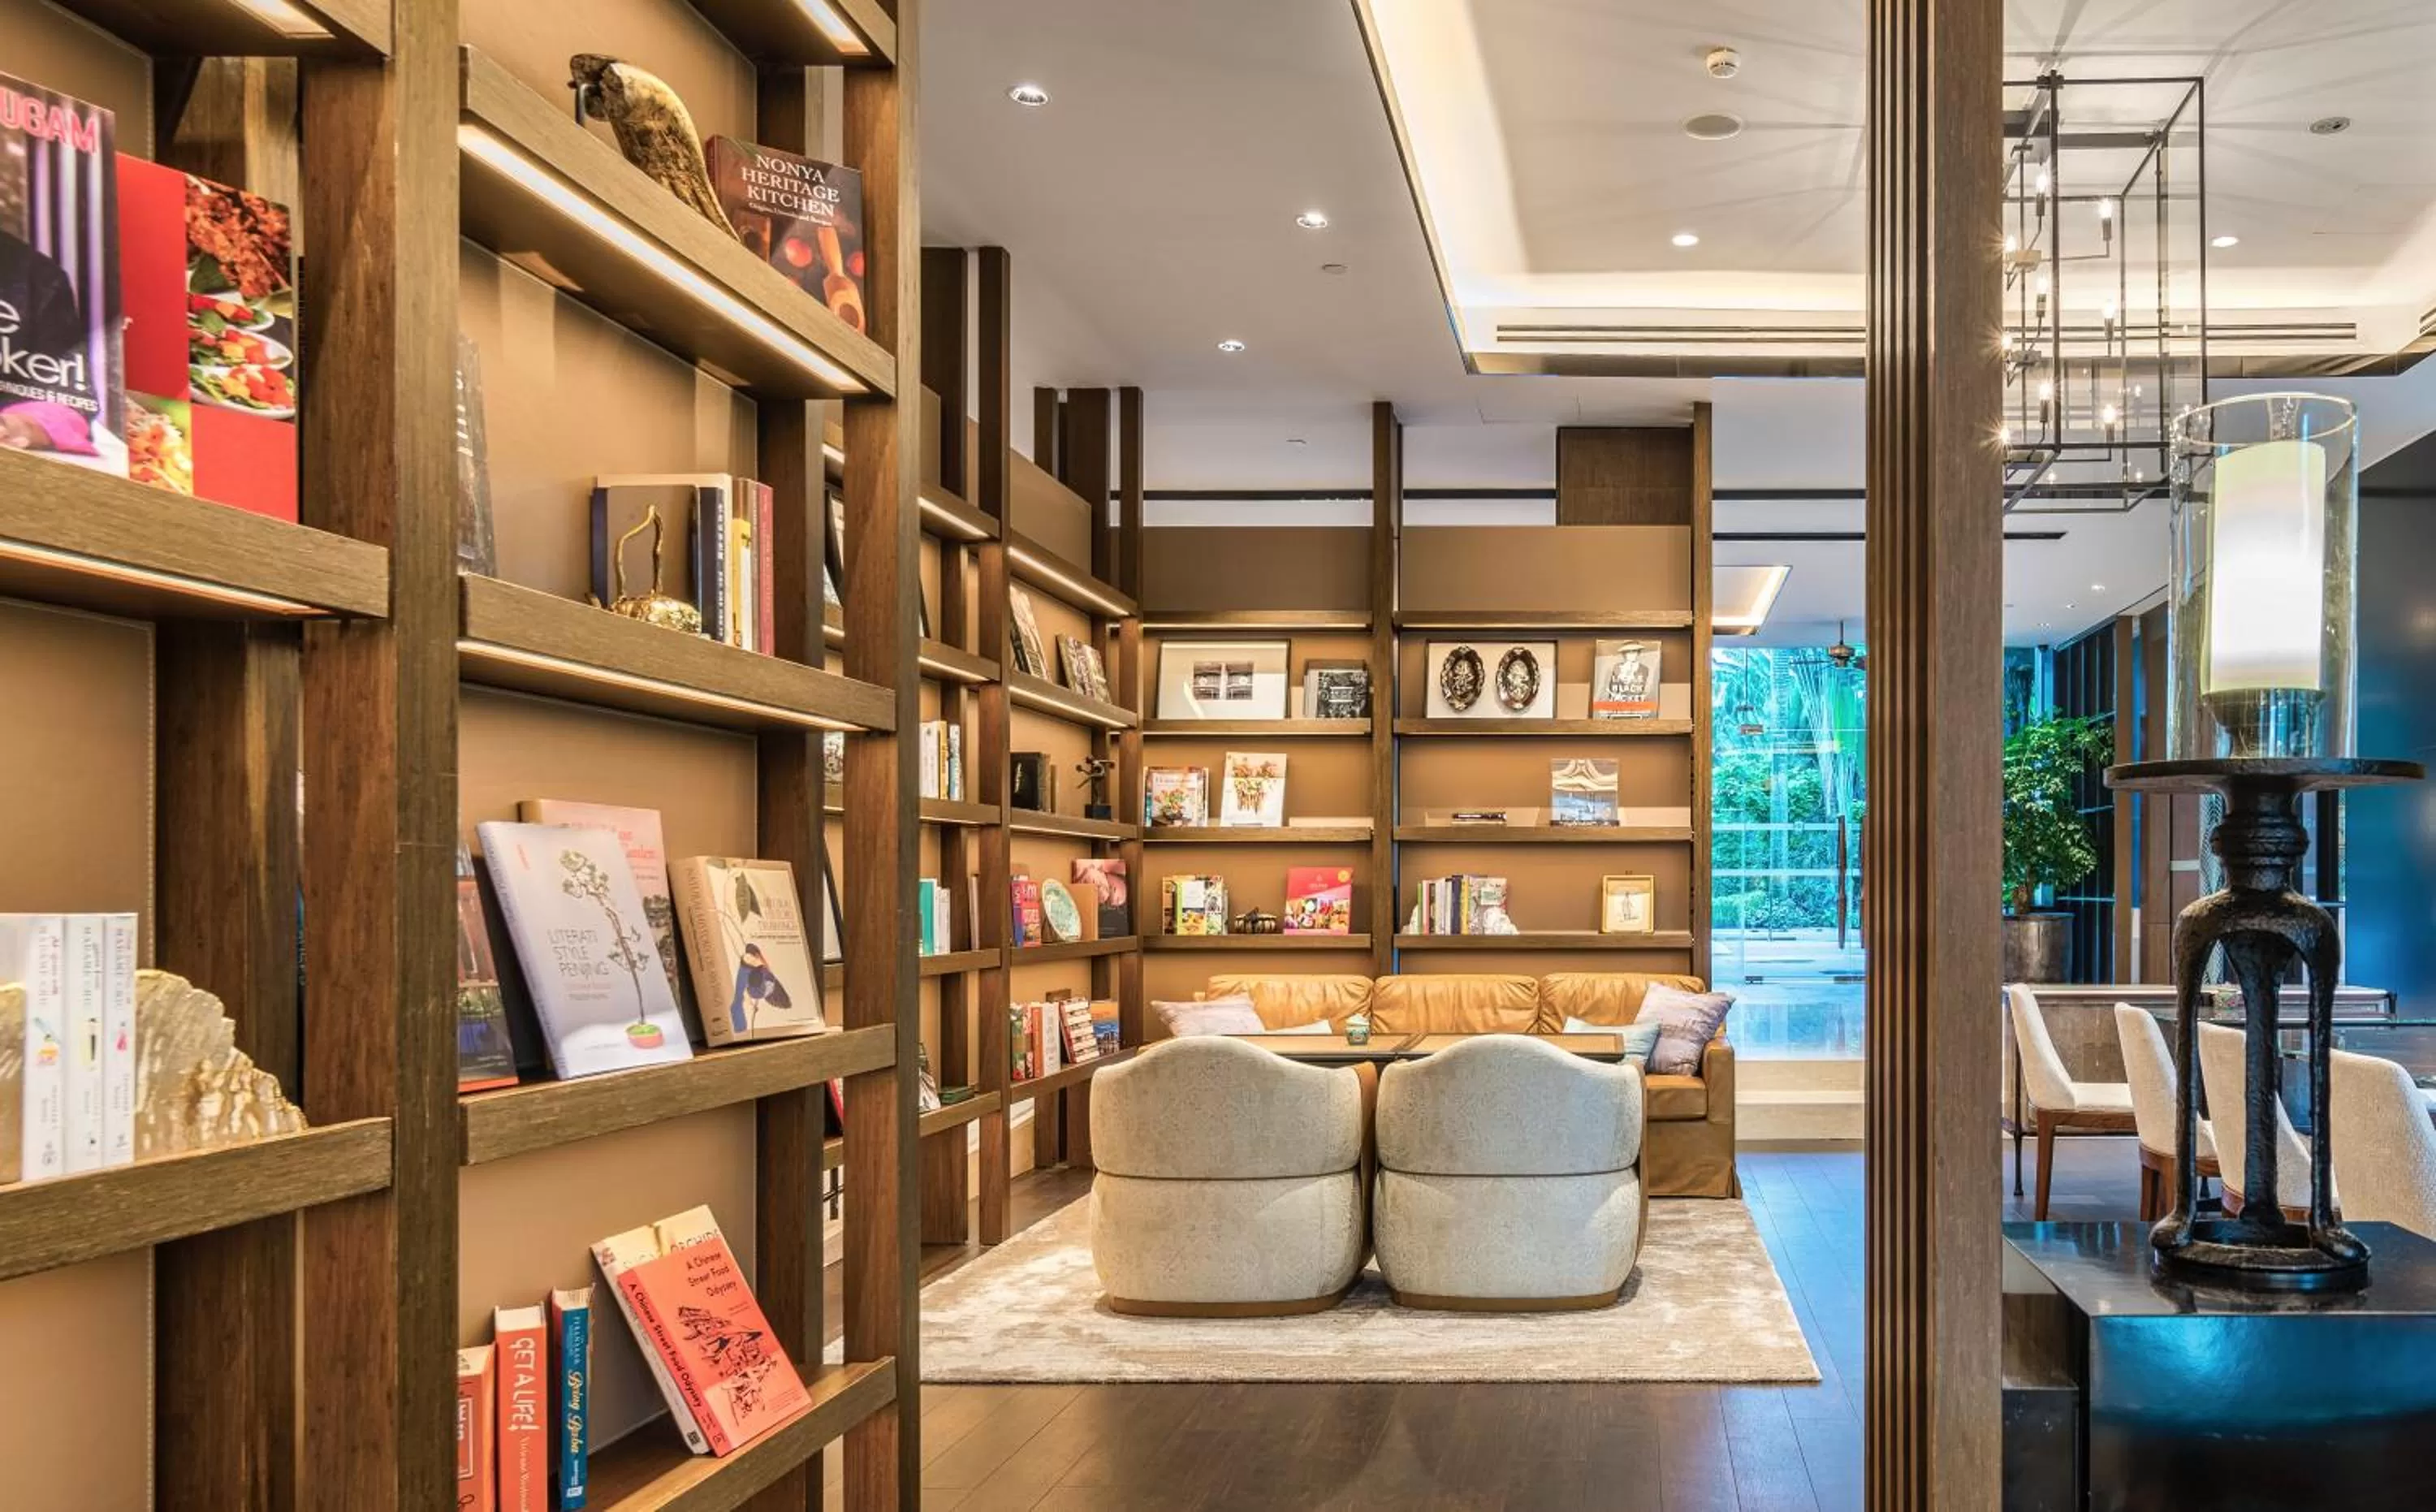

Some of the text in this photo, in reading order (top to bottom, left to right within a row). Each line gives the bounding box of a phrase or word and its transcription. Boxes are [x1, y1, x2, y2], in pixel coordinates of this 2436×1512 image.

[741, 166, 840, 203] HERITAGE
[755, 153, 825, 184] NONYA
[747, 184, 835, 218] KITCHEN
[0, 335, 87, 391] ker!
[693, 1251, 722, 1268] Chinese
[710, 1265, 730, 1277] Food
[706, 1281, 738, 1297] Odyssey
[628, 1283, 637, 1294] A
[634, 1291, 655, 1324] Chinese
[653, 1324, 672, 1350] Street
[668, 1350, 686, 1372] Food
[680, 1371, 702, 1408] Odyssey
[506, 1337, 540, 1432] GET A LIFE!
